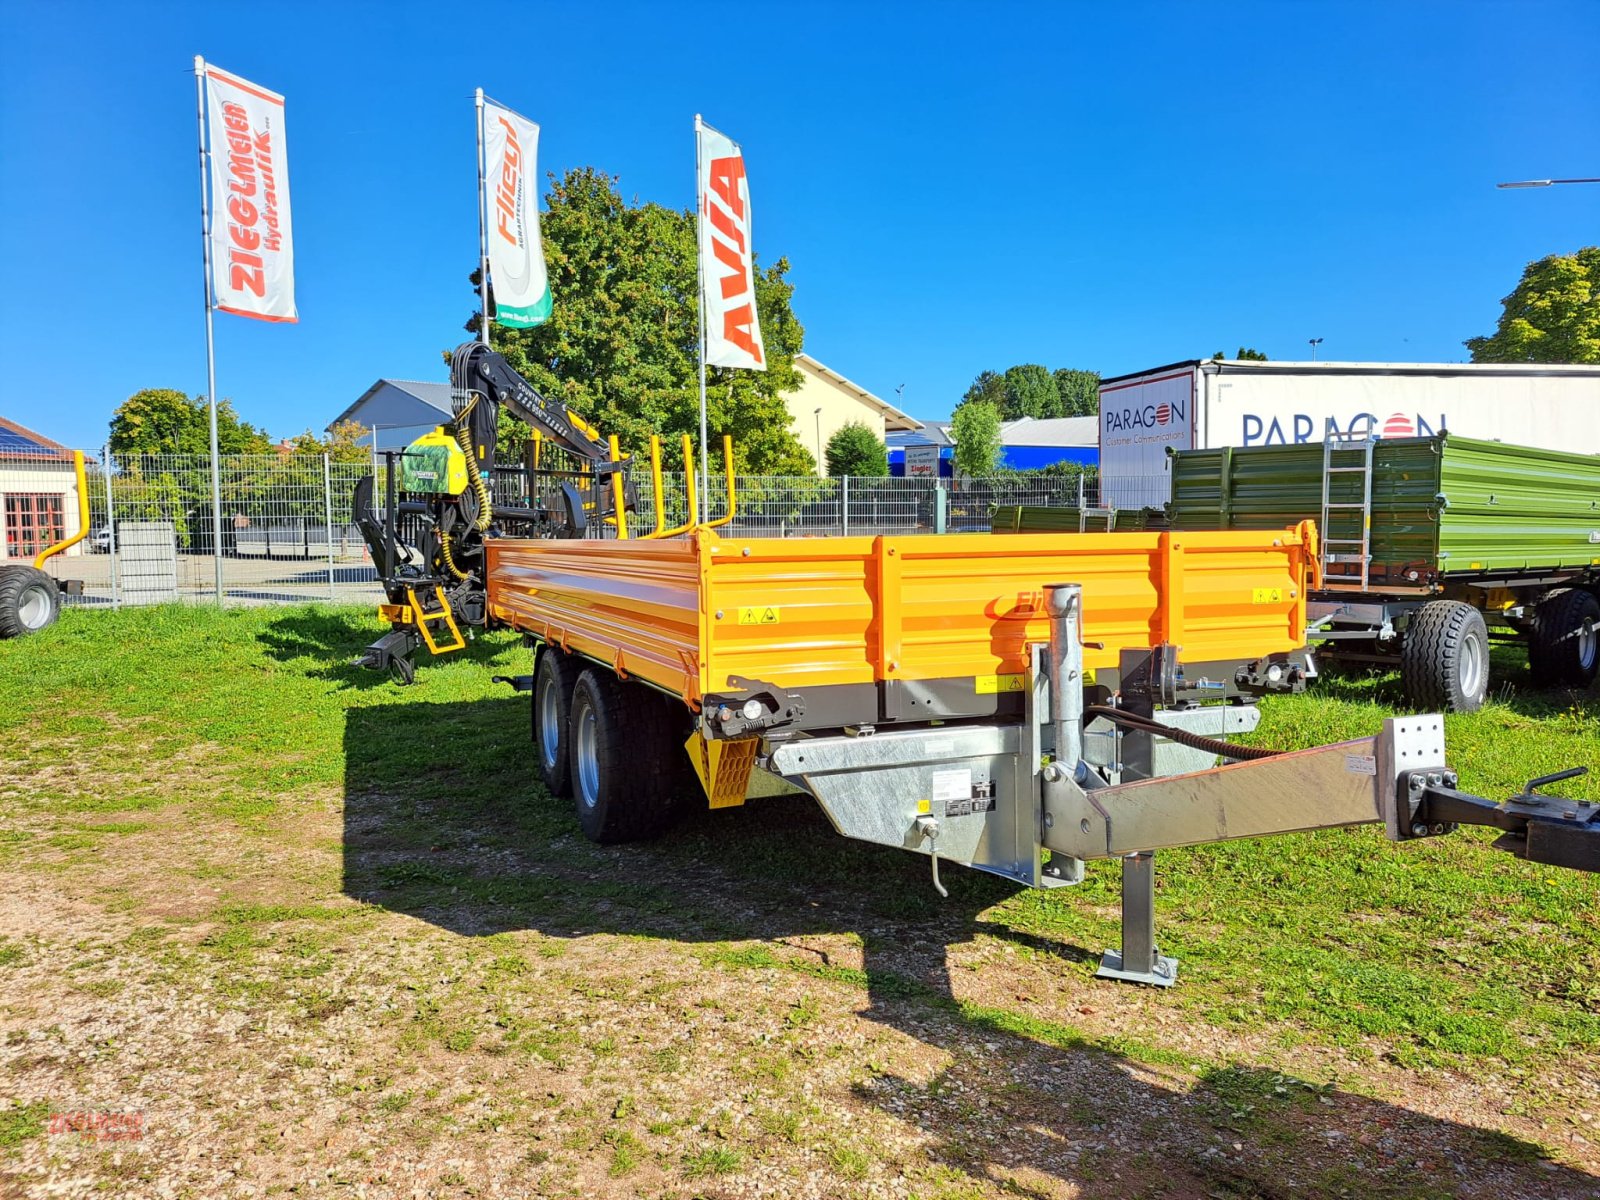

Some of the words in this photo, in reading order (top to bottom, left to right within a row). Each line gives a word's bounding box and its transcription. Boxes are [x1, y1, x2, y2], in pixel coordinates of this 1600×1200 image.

[222, 100, 266, 298] ZIEGLMEIER
[253, 127, 282, 252] Hydraulik
[496, 115, 523, 246] Fliegl
[703, 155, 762, 364] AVIA
[1105, 437, 1132, 447] Customer
[1133, 431, 1185, 444] Communications
[1106, 399, 1185, 433] PARAGON
